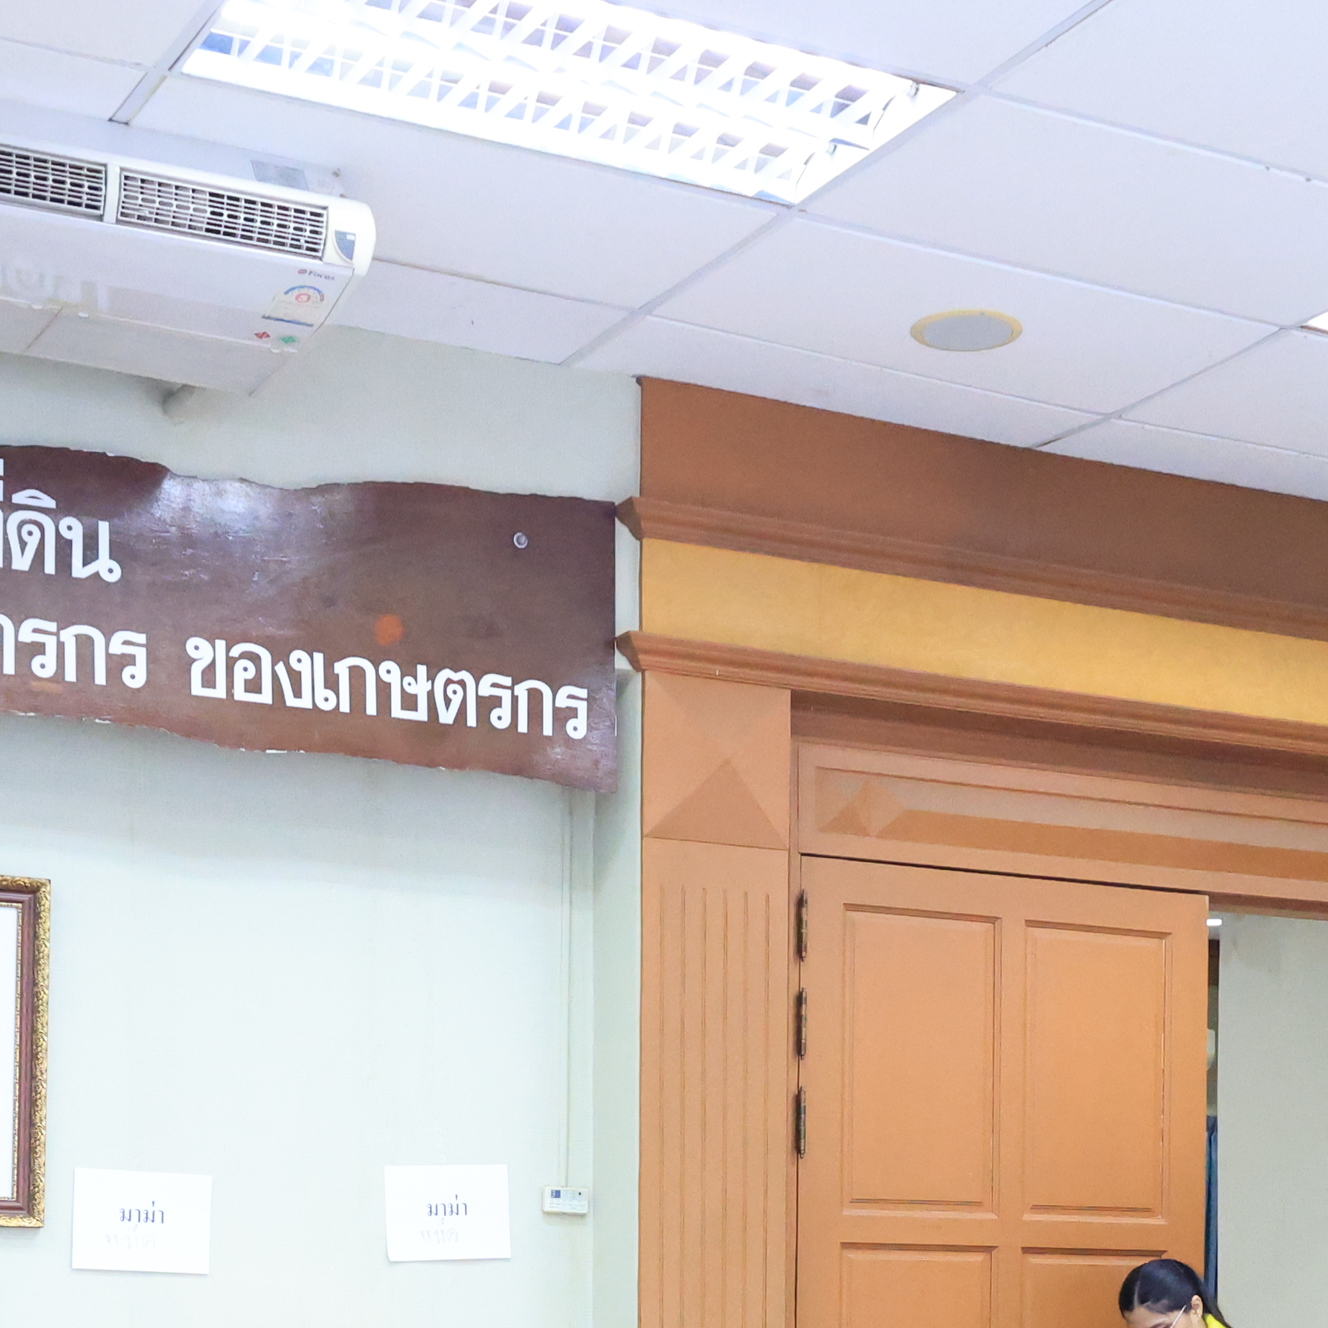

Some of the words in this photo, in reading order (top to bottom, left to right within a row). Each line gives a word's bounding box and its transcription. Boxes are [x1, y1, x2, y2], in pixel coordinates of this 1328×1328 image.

[187, 635, 590, 742] ของเกษตรกร
[119, 1200, 165, 1224] มาม่า
[427, 1194, 468, 1217] มาม่า
